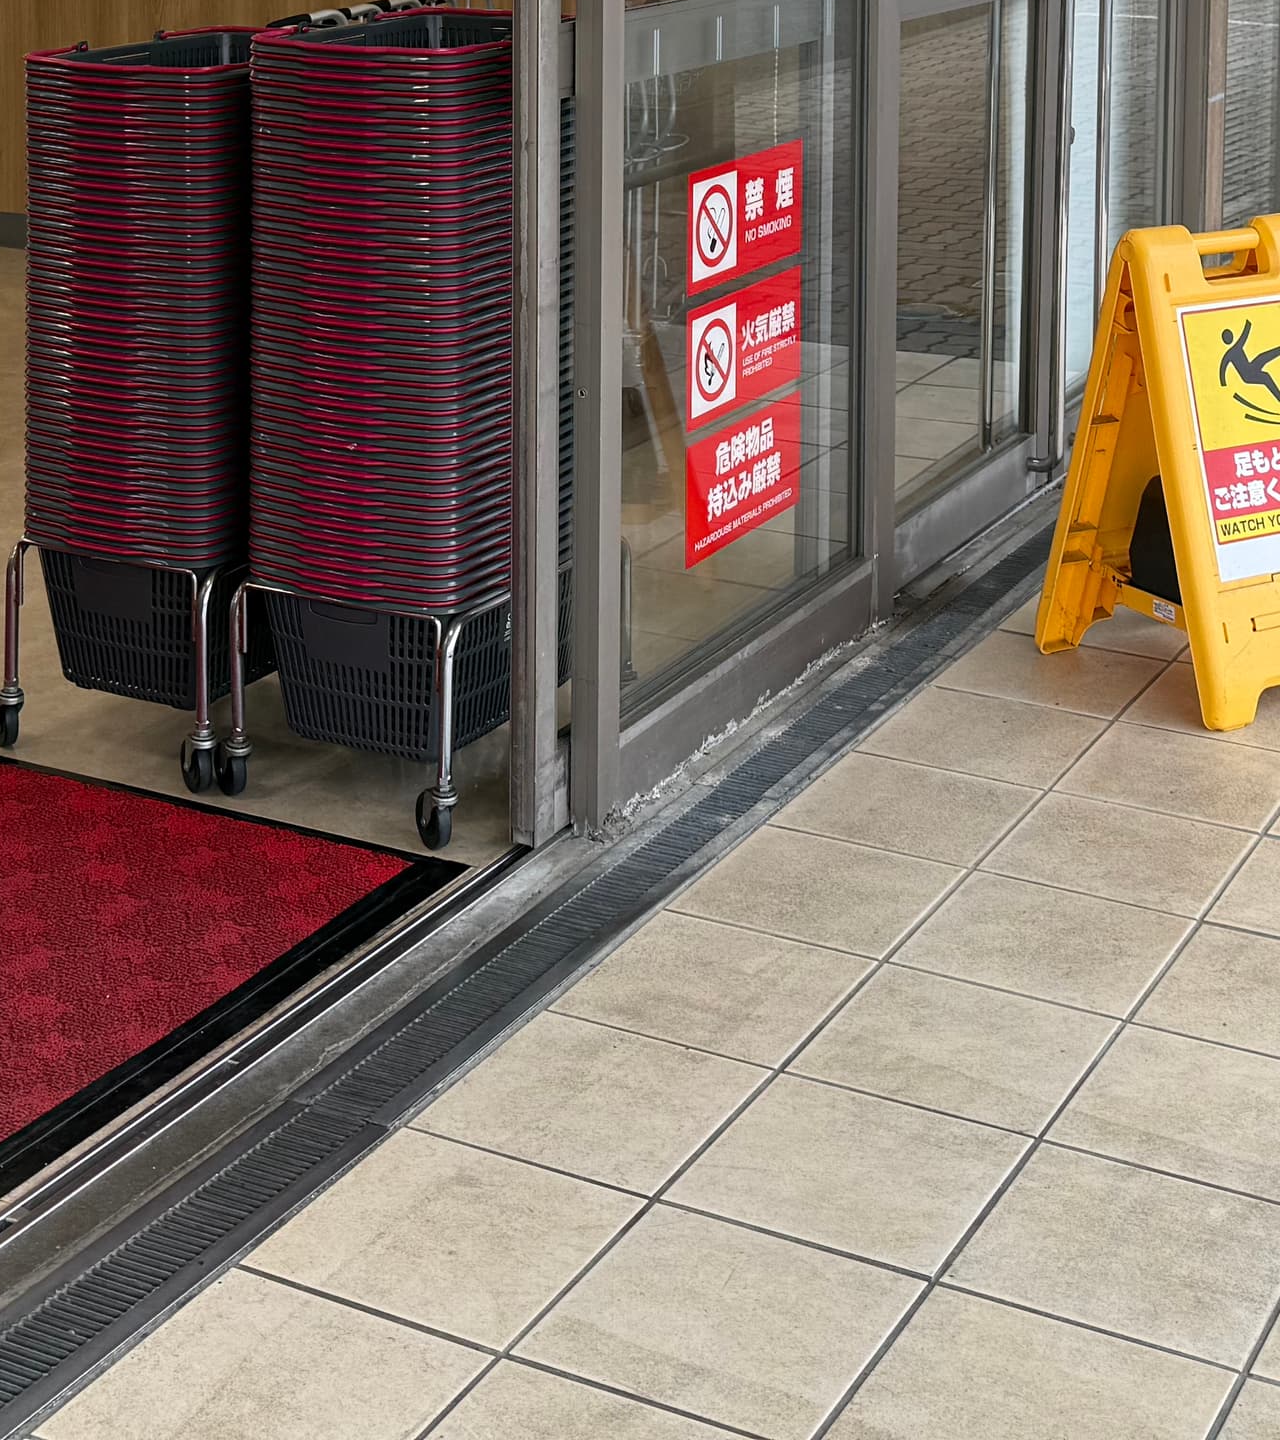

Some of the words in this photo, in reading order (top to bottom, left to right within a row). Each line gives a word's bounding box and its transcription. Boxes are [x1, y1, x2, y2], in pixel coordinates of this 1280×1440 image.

[744, 166, 795, 222] 禁煙
[745, 227, 757, 243] NO
[758, 215, 792, 239] SMOKING
[741, 300, 796, 353] 火気厳禁
[742, 353, 754, 367] USE
[742, 357, 773, 378] PROHIBITED
[715, 416, 775, 477] 危険物品
[707, 451, 782, 523] 持込み厳禁
[732, 504, 762, 531] MATERIALS
[762, 487, 793, 512] PROHIBITED
[1220, 517, 1266, 537] WATCH
